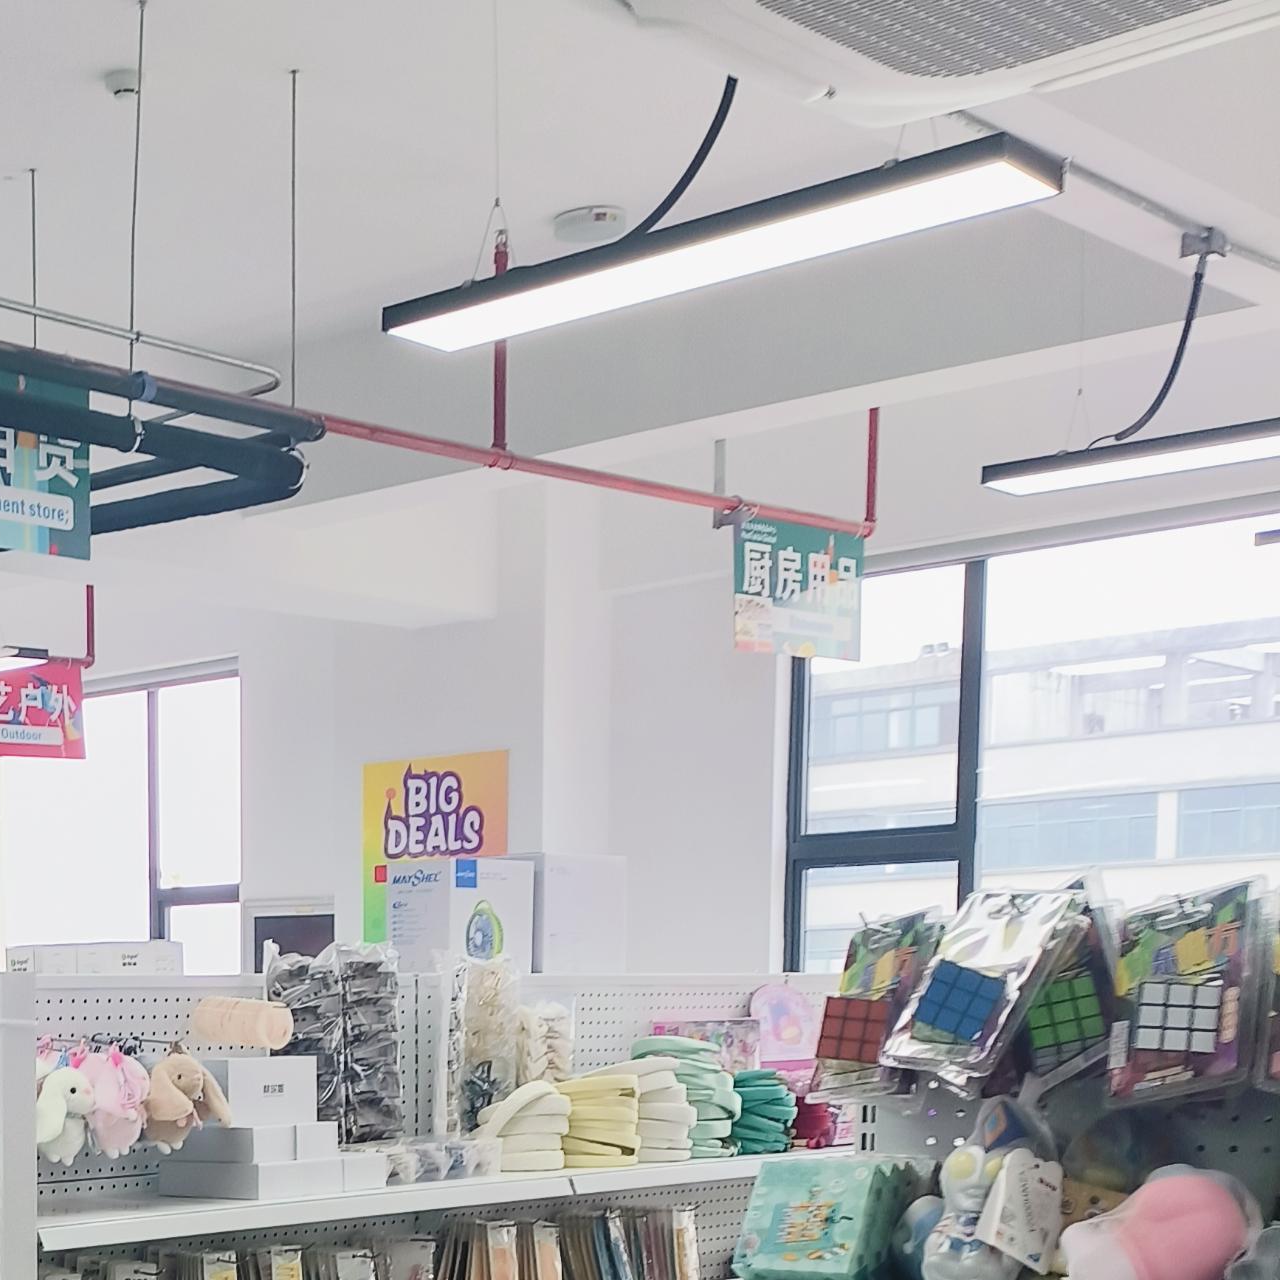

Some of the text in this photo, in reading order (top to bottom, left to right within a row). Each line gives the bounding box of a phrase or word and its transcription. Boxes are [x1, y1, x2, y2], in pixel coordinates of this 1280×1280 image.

[743, 541, 857, 605] 厨房用品
[1, 727, 43, 742] Outdoor
[406, 774, 460, 817] BIG
[386, 808, 482, 855] DEALS
